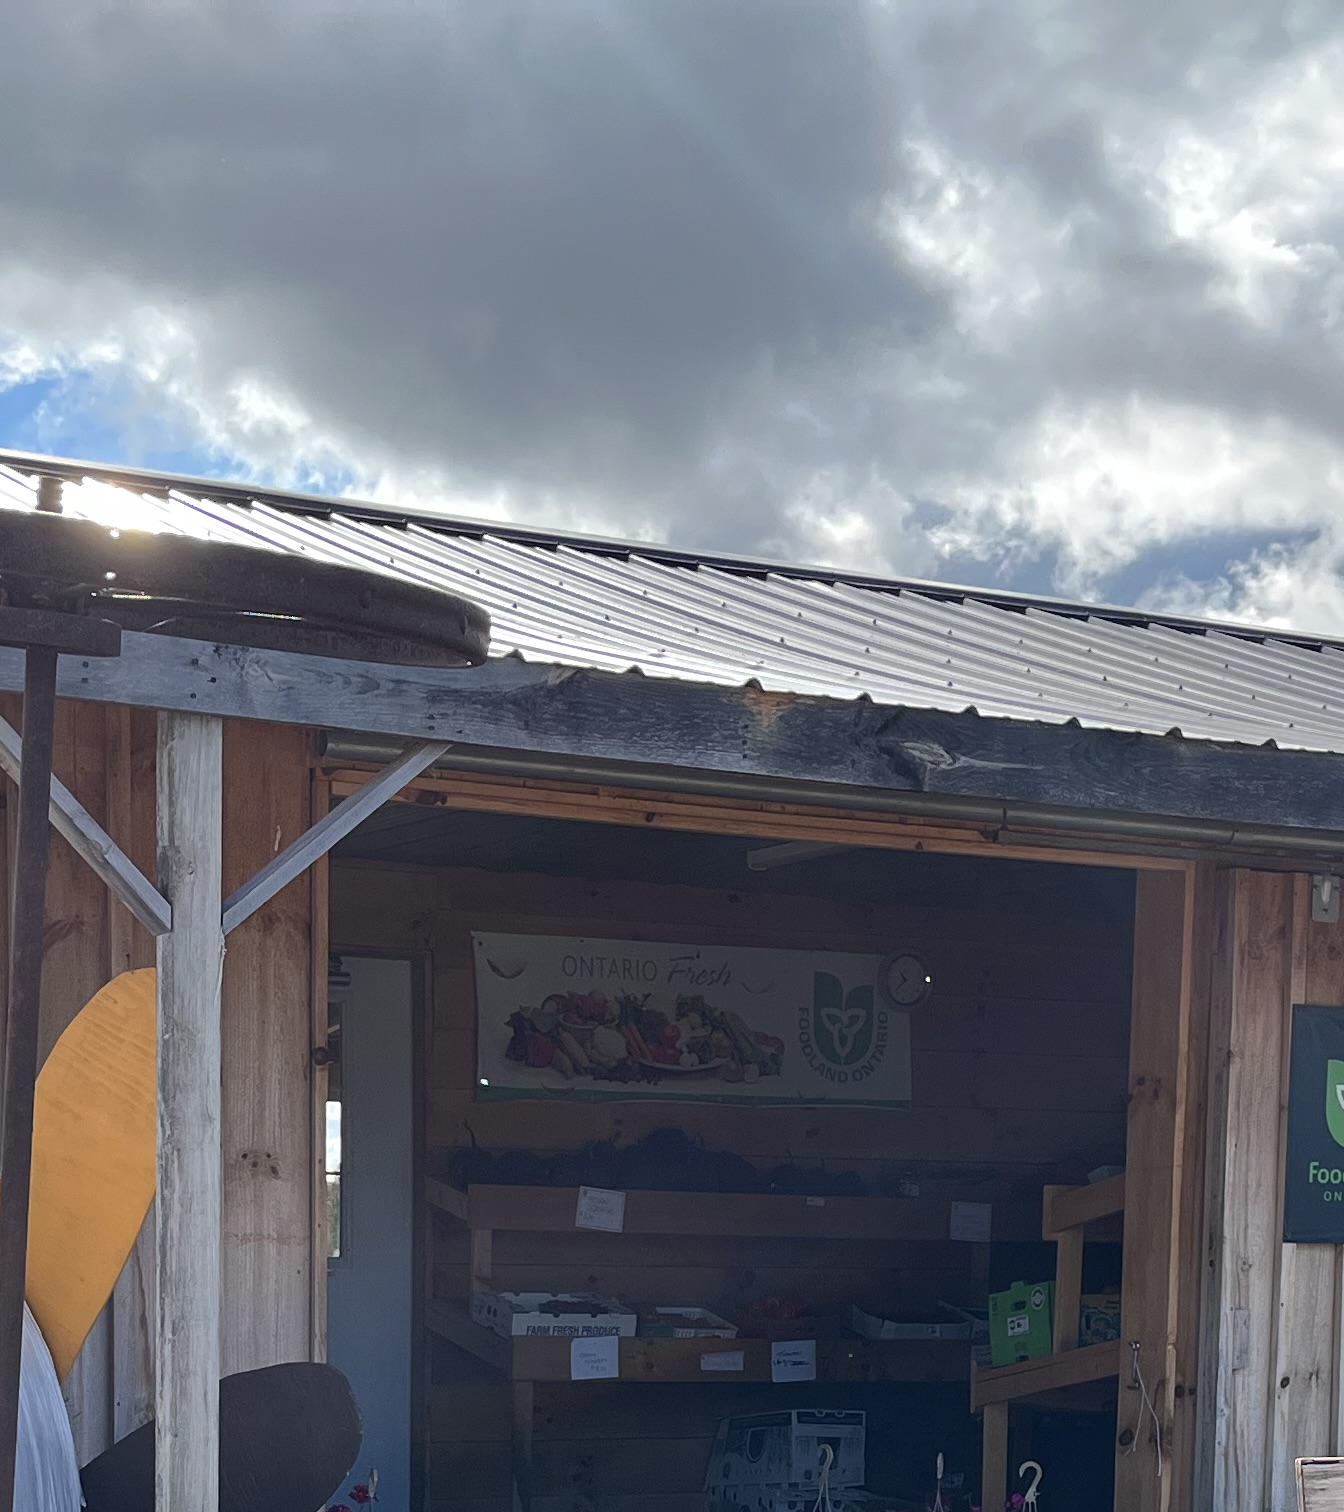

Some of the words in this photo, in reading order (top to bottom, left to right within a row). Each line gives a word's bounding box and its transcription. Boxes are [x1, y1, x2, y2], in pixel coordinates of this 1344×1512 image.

[561, 955, 658, 982] ONTARIO
[666, 951, 733, 988] Fresh
[798, 1007, 849, 1084] FOODLAND
[850, 1011, 889, 1082] ONTARIO
[527, 1326, 550, 1336] FARM
[552, 1326, 579, 1336] FRESH
[582, 1326, 621, 1336] PRODUCE
